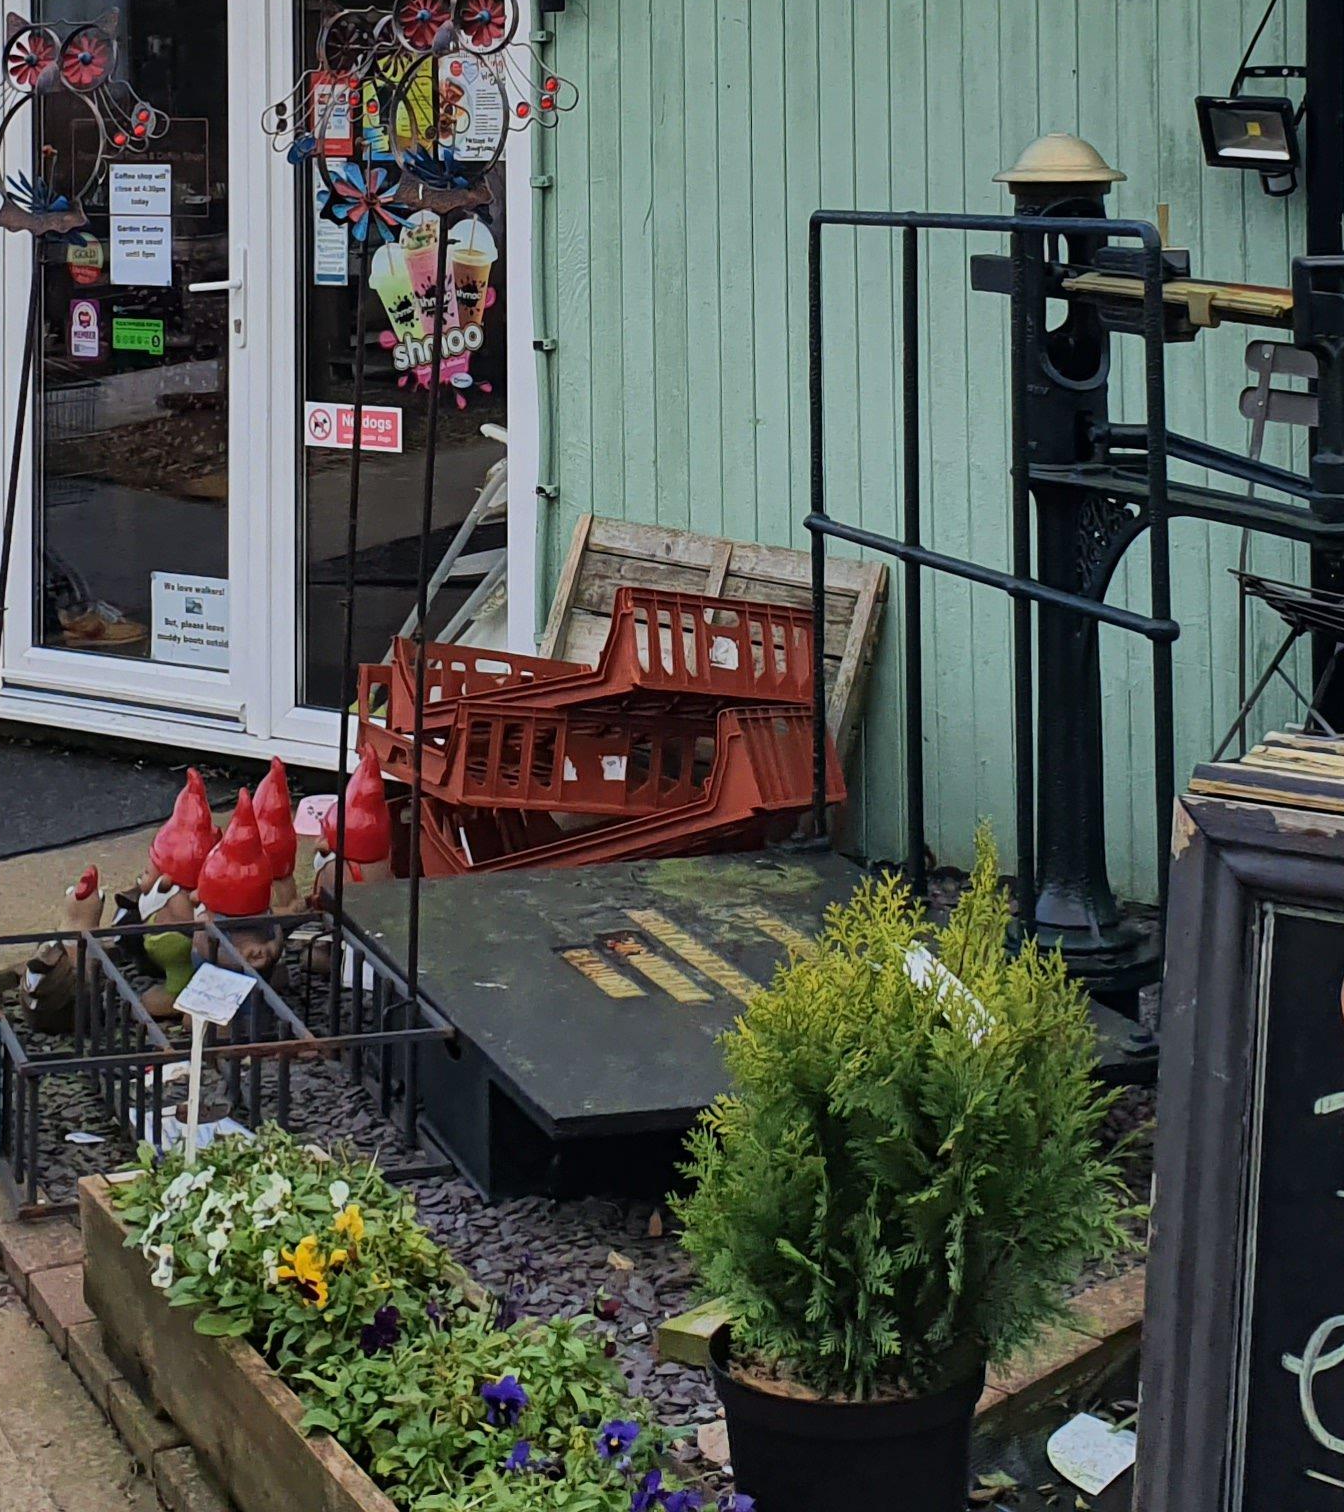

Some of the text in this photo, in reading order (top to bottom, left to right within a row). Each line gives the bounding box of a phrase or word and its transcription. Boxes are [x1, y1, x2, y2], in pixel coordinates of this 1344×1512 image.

[137, 172, 152, 181] shop
[131, 198, 149, 207] today
[362, 414, 392, 433] dogs
[177, 583, 193, 592] love
[195, 586, 225, 596] walkers!
[181, 620, 204, 630] please
[157, 633, 229, 648] muddy boots outsid
